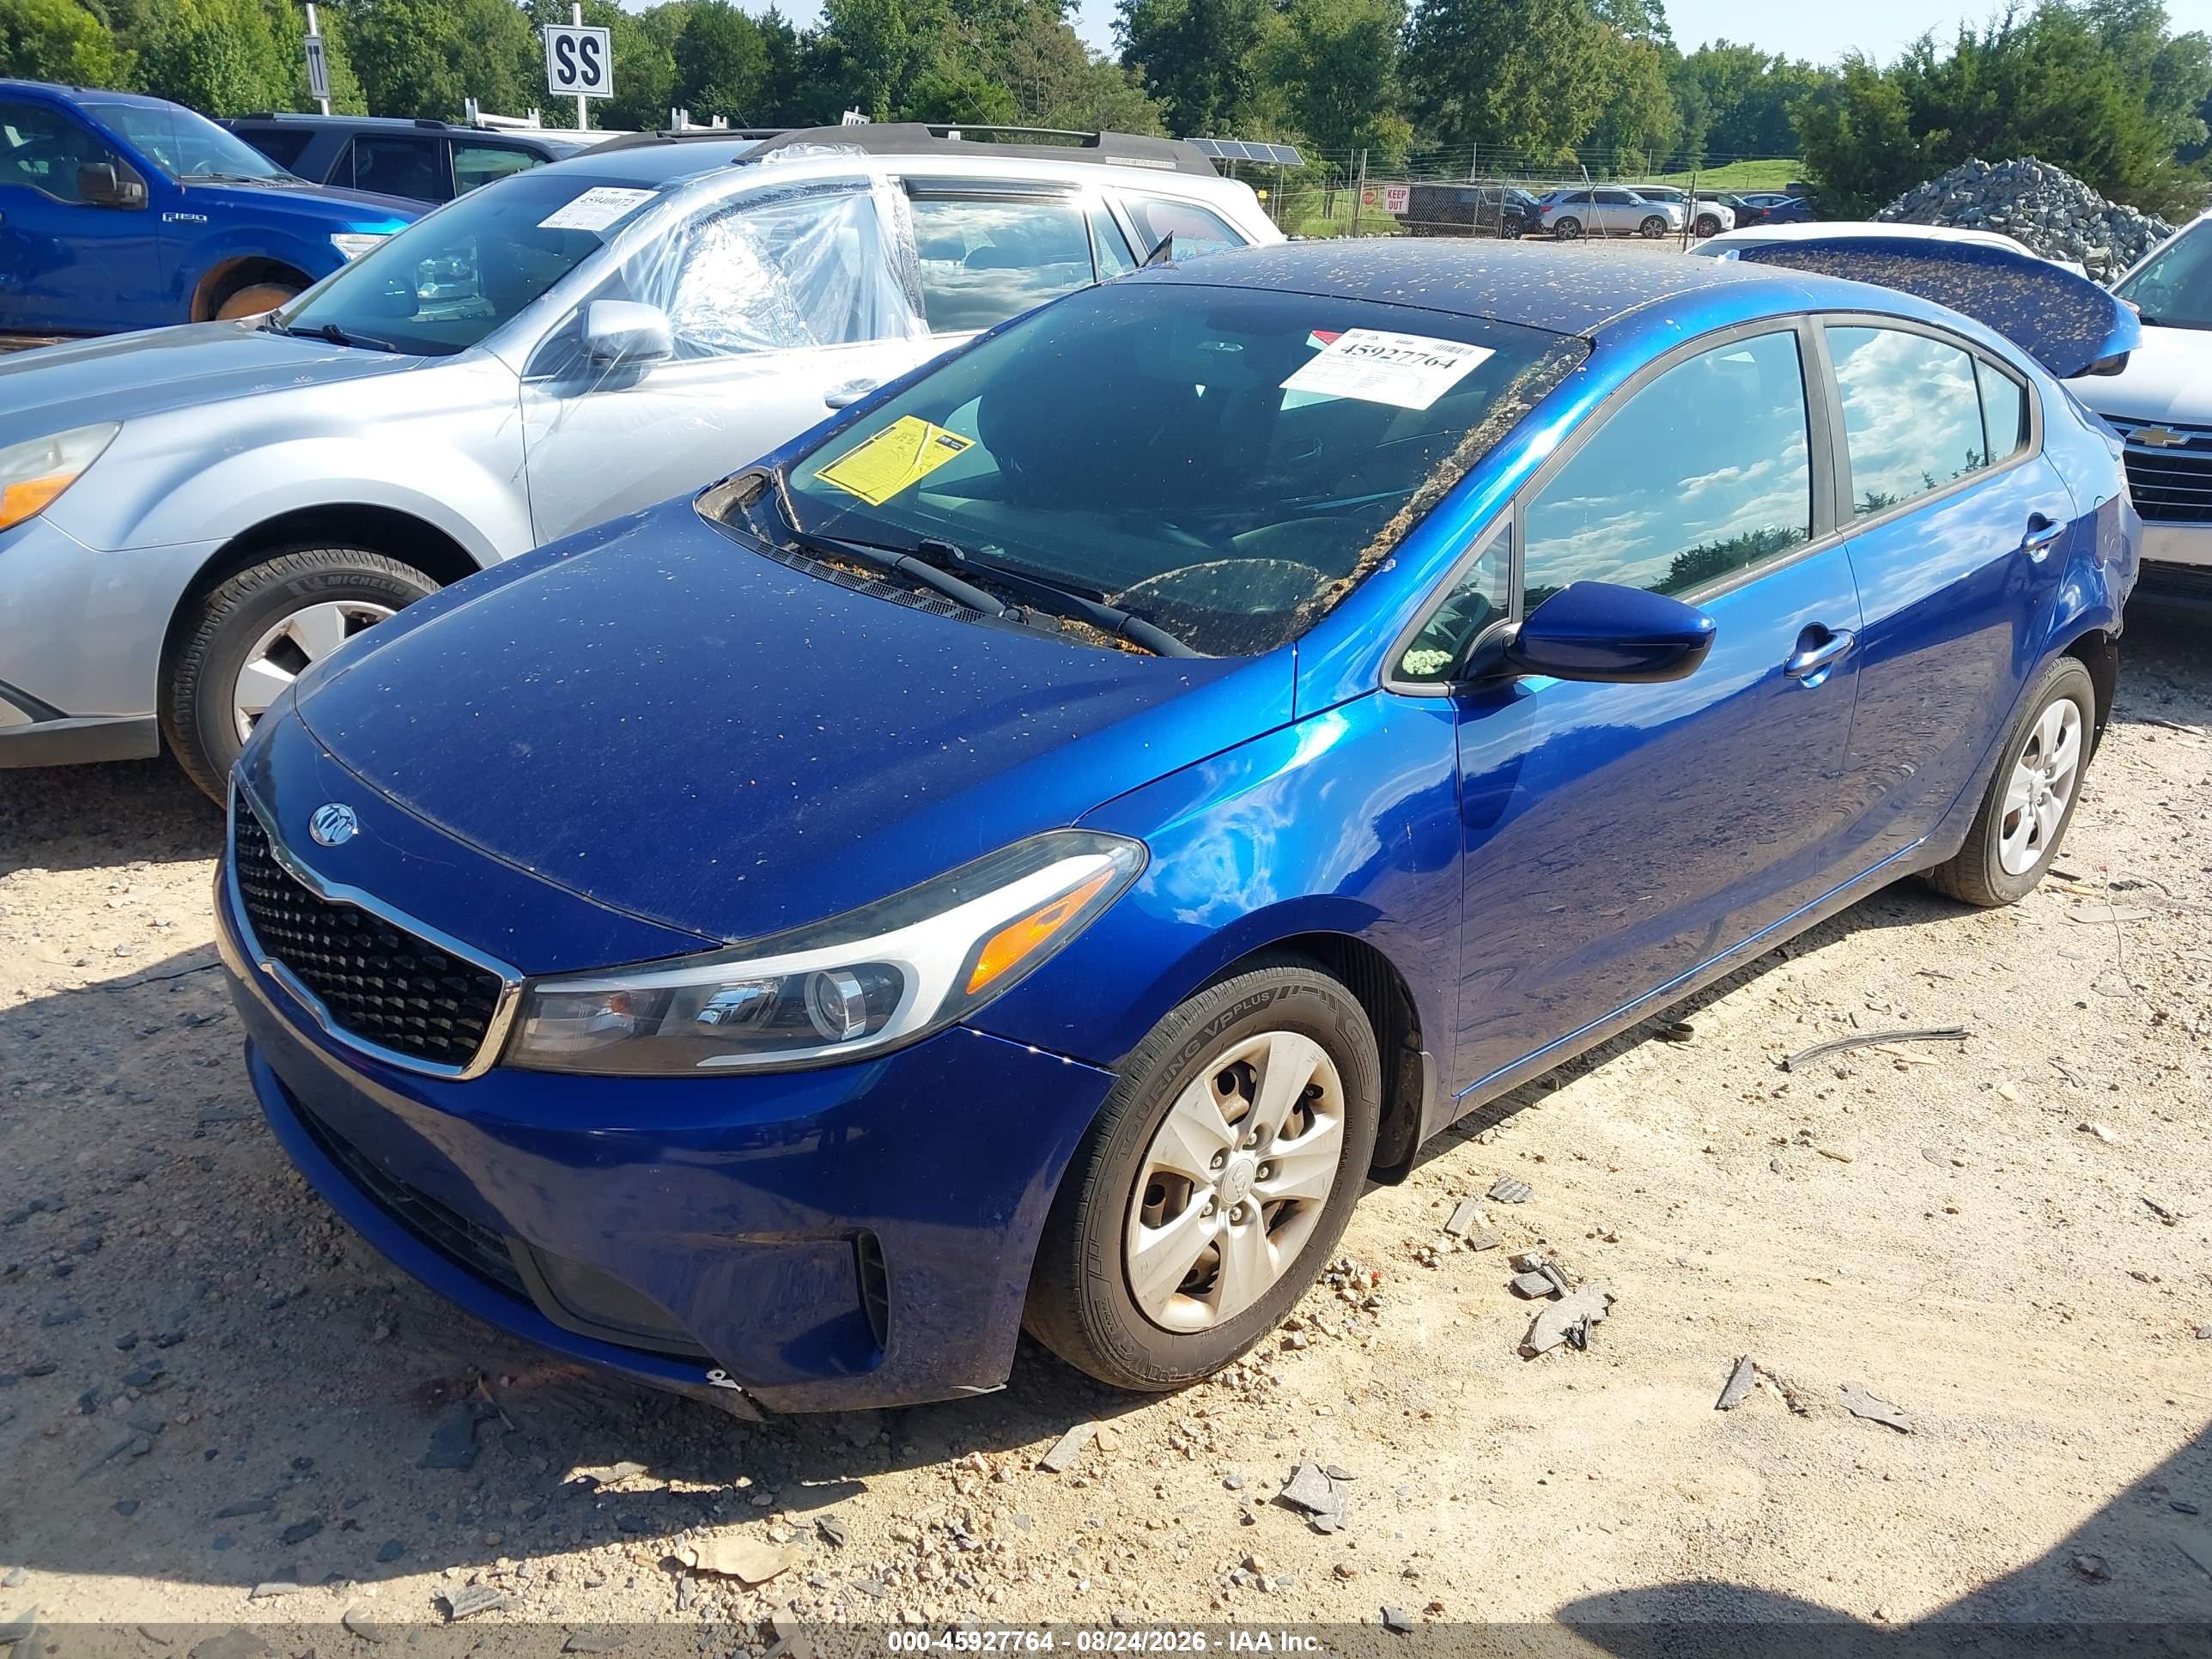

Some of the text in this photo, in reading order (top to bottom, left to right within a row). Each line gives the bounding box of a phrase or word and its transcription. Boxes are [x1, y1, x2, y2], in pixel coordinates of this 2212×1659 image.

[555, 34, 601, 87] SS
[1387, 189, 1407, 199] KEEP
[1389, 200, 1404, 210] OUT
[1340, 343, 1458, 369] 45927764
[327, 575, 407, 597] MICHELIN
[1115, 1039, 1201, 1161] TOURING
